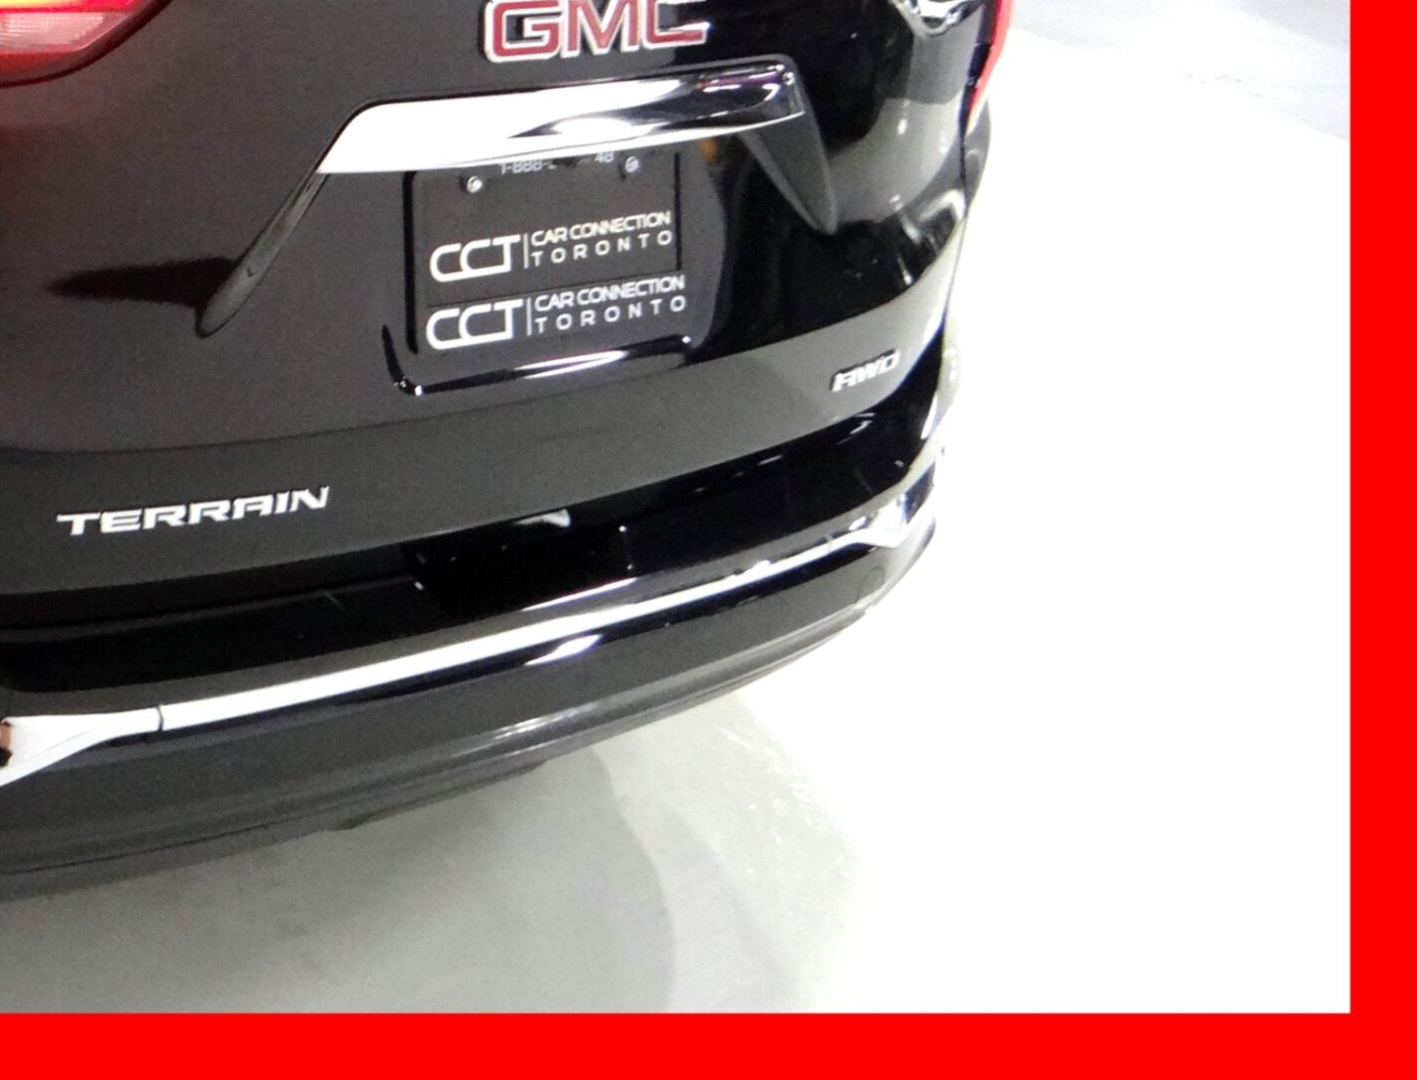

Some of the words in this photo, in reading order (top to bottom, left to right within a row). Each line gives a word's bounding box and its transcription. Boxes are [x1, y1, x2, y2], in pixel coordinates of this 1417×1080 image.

[530, 225, 568, 247] CAR
[569, 210, 672, 241] CONNECTION
[530, 229, 673, 267] TORONTO
[429, 234, 522, 282] CCT
[534, 289, 575, 312] CAR
[576, 275, 685, 305] CONNECTION
[426, 299, 524, 350] CCT
[534, 295, 686, 334] TORONTO
[832, 349, 901, 392] AWD
[56, 486, 330, 536] TERRAIN
